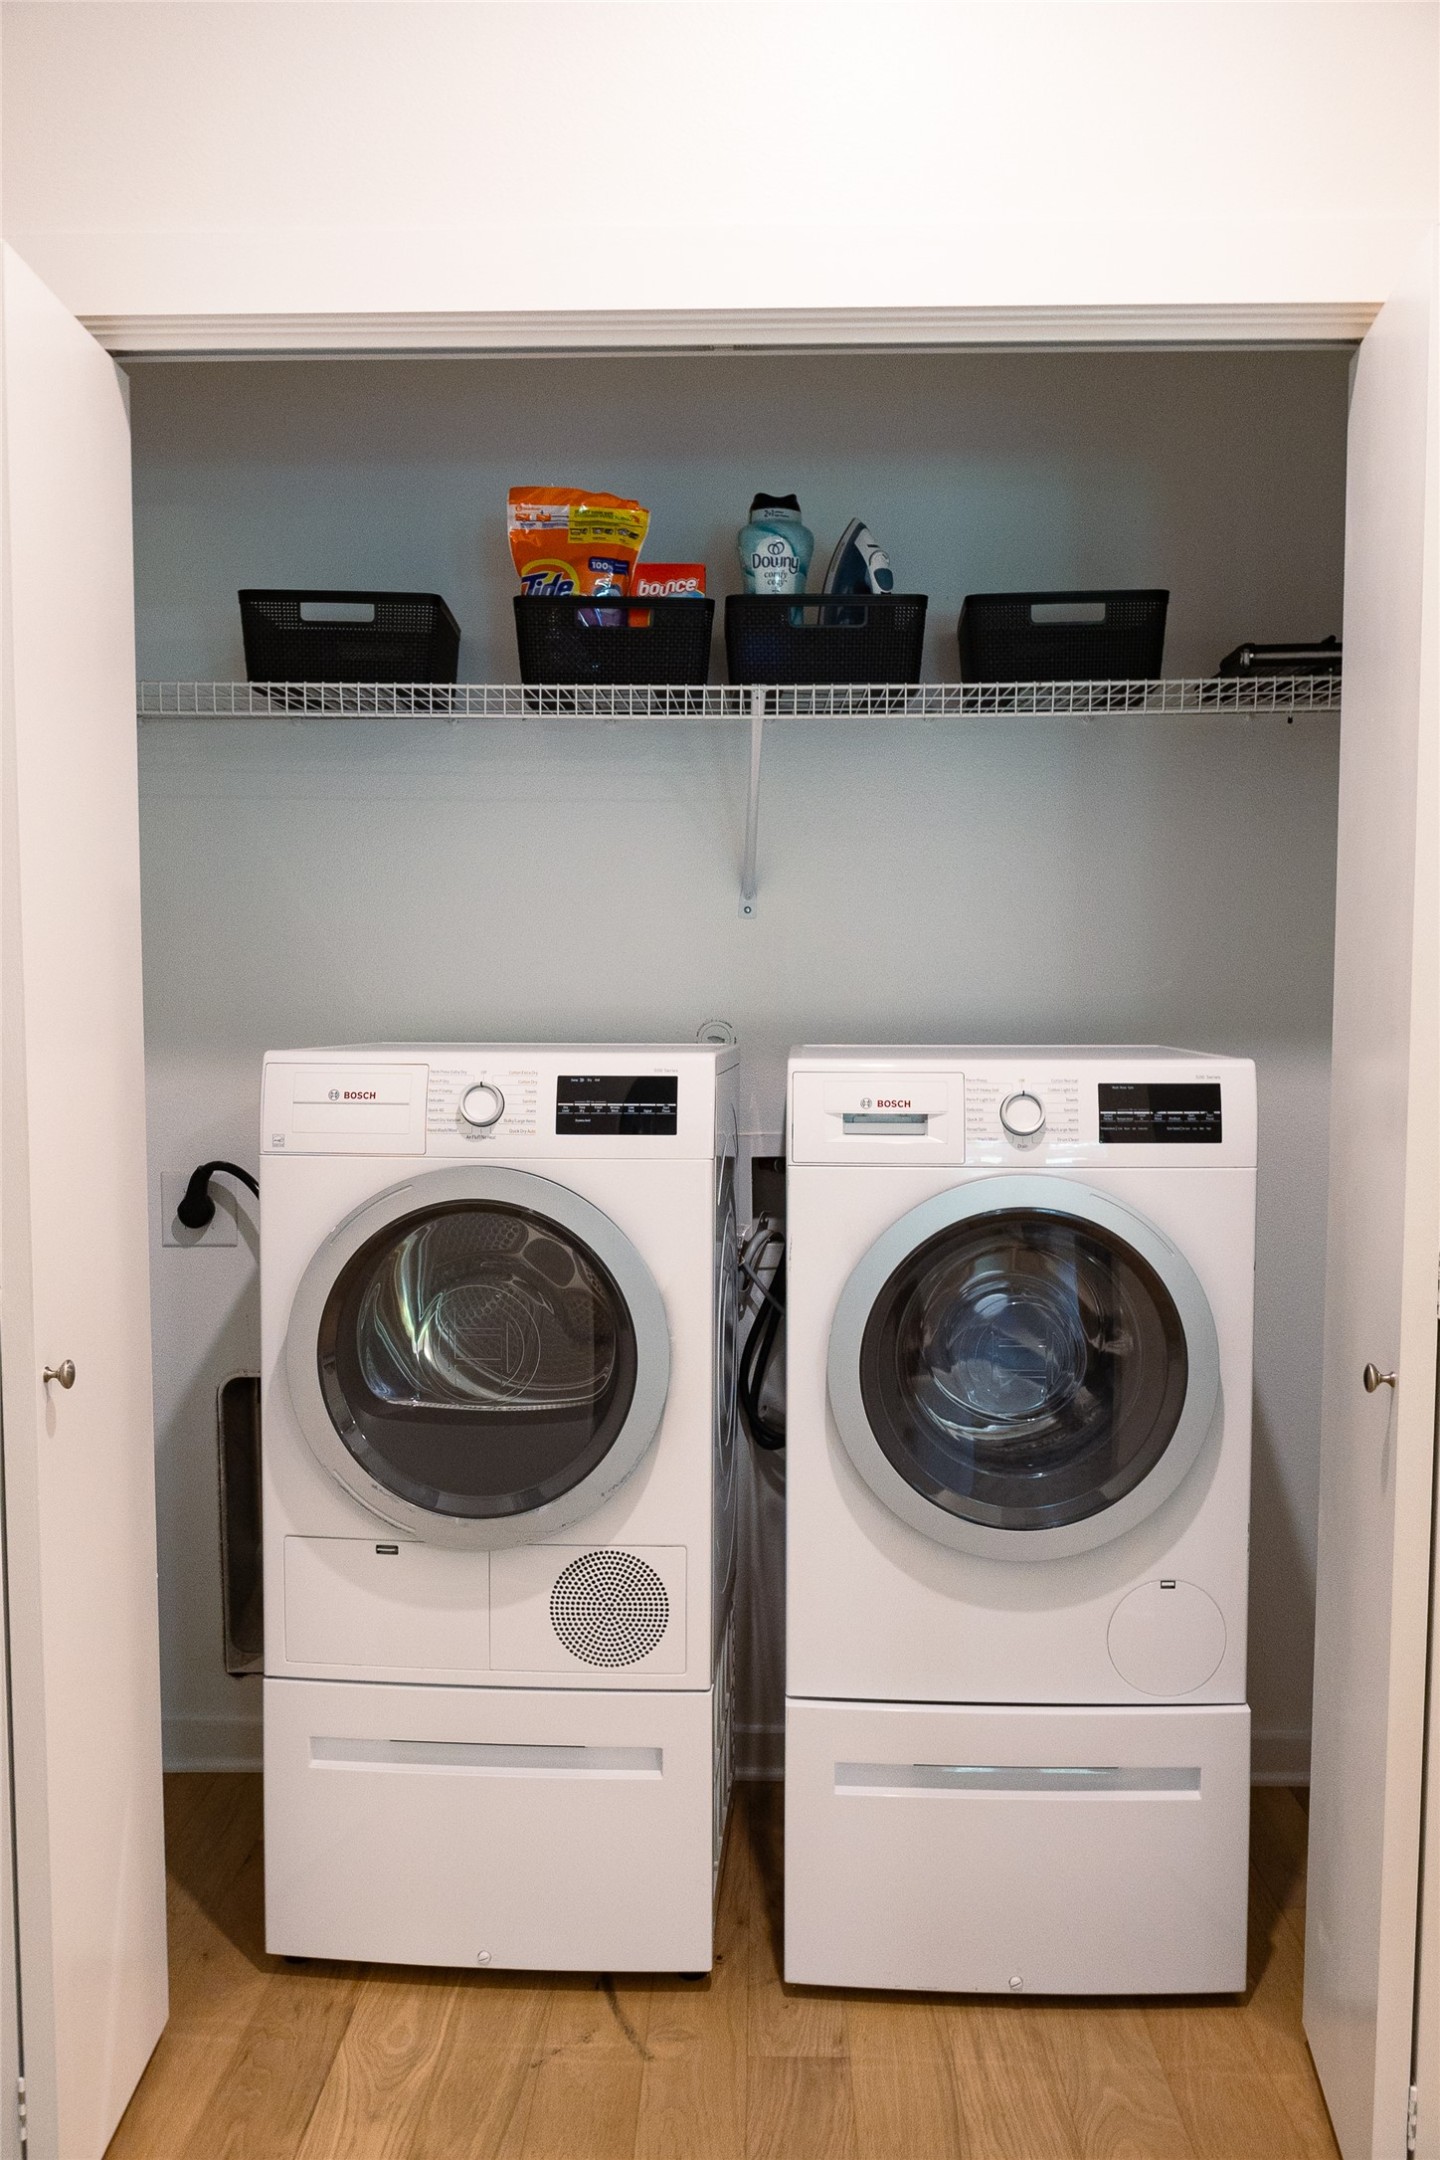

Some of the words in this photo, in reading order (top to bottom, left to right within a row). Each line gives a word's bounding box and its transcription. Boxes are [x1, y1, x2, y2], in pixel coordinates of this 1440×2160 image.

[752, 553, 799, 575] Downy
[521, 572, 575, 596] Tide
[638, 578, 698, 597] bounce
[343, 1091, 376, 1100] BOSCH
[877, 1099, 911, 1108] BOSCH
